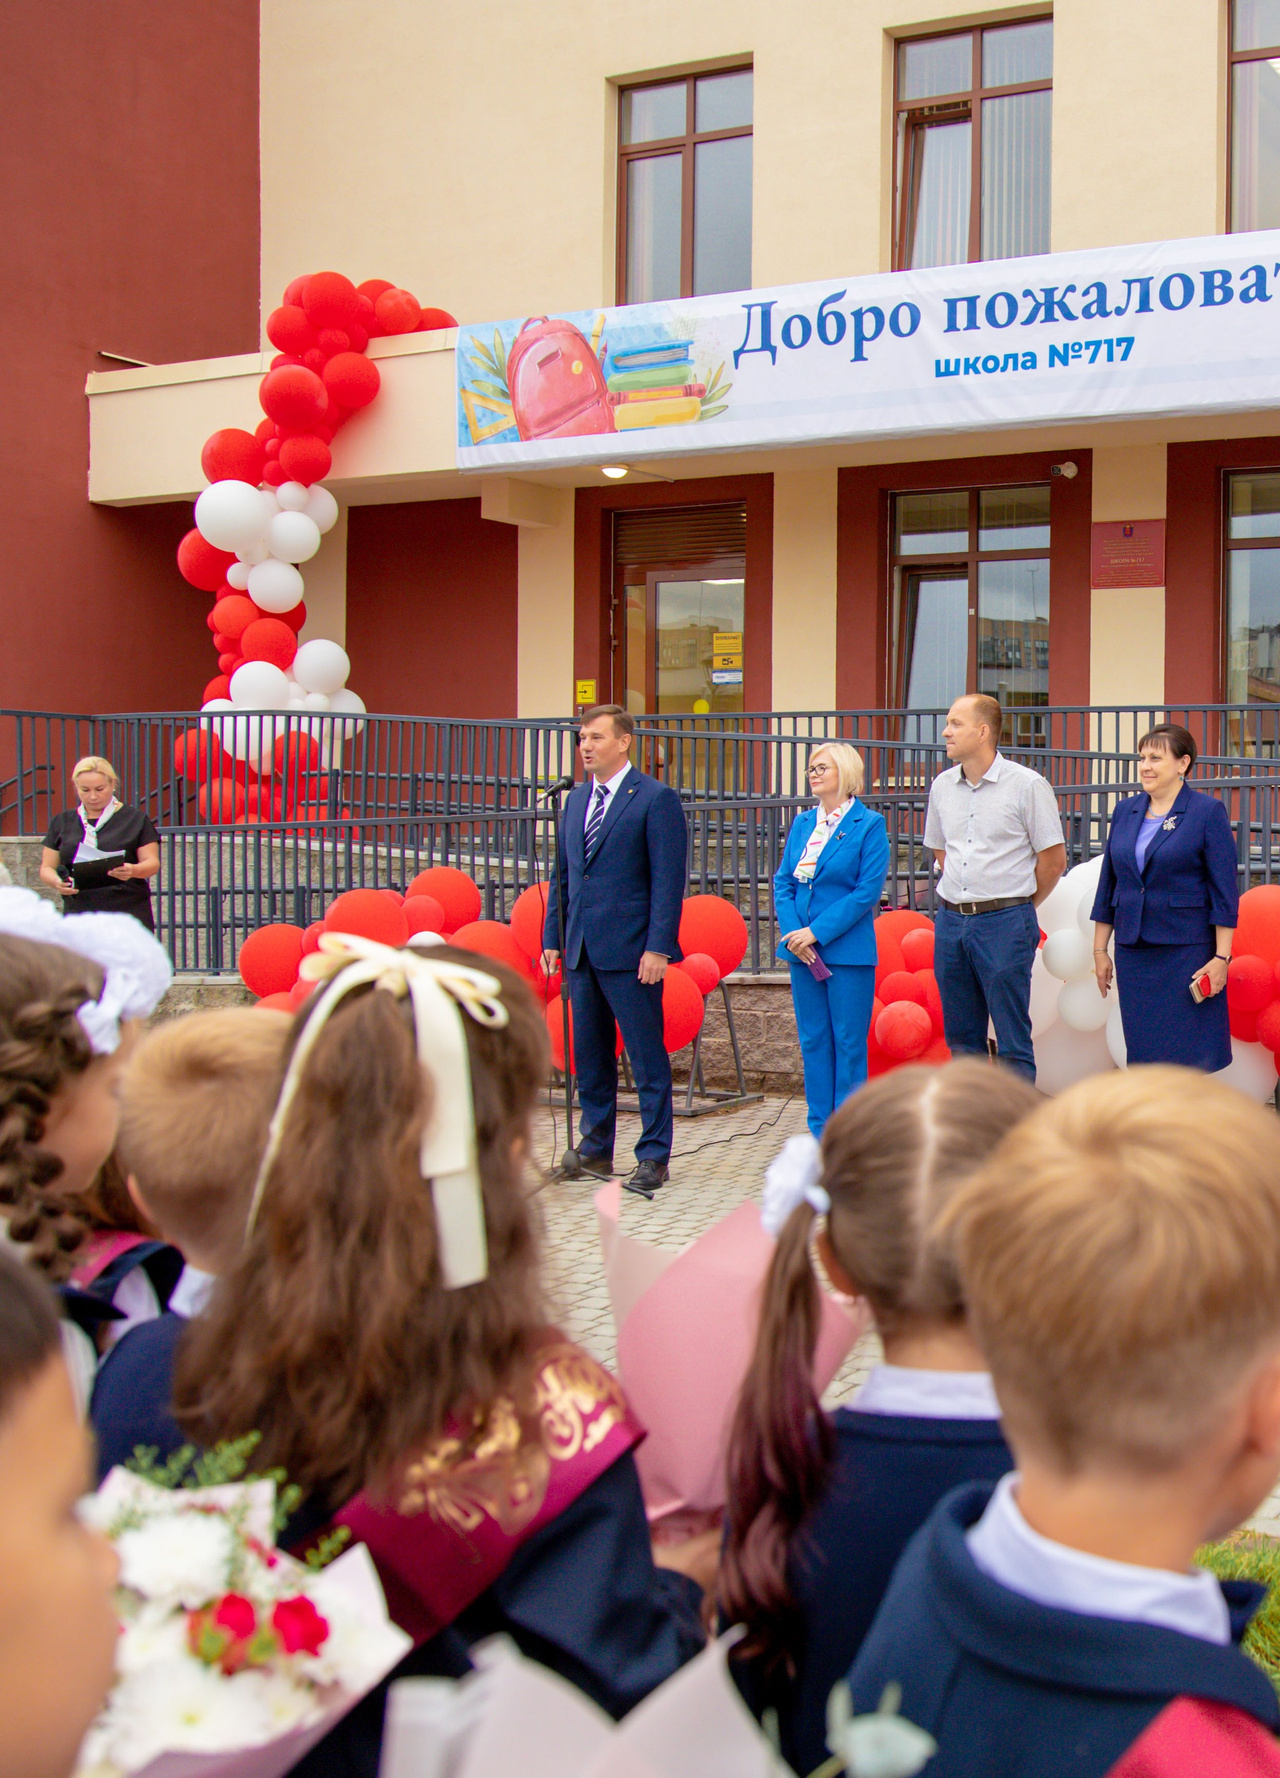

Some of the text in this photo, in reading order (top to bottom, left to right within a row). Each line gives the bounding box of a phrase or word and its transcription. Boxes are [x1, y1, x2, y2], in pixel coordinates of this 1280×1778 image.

[732, 289, 921, 370] Добро
[934, 336, 1135, 378] школа №717
